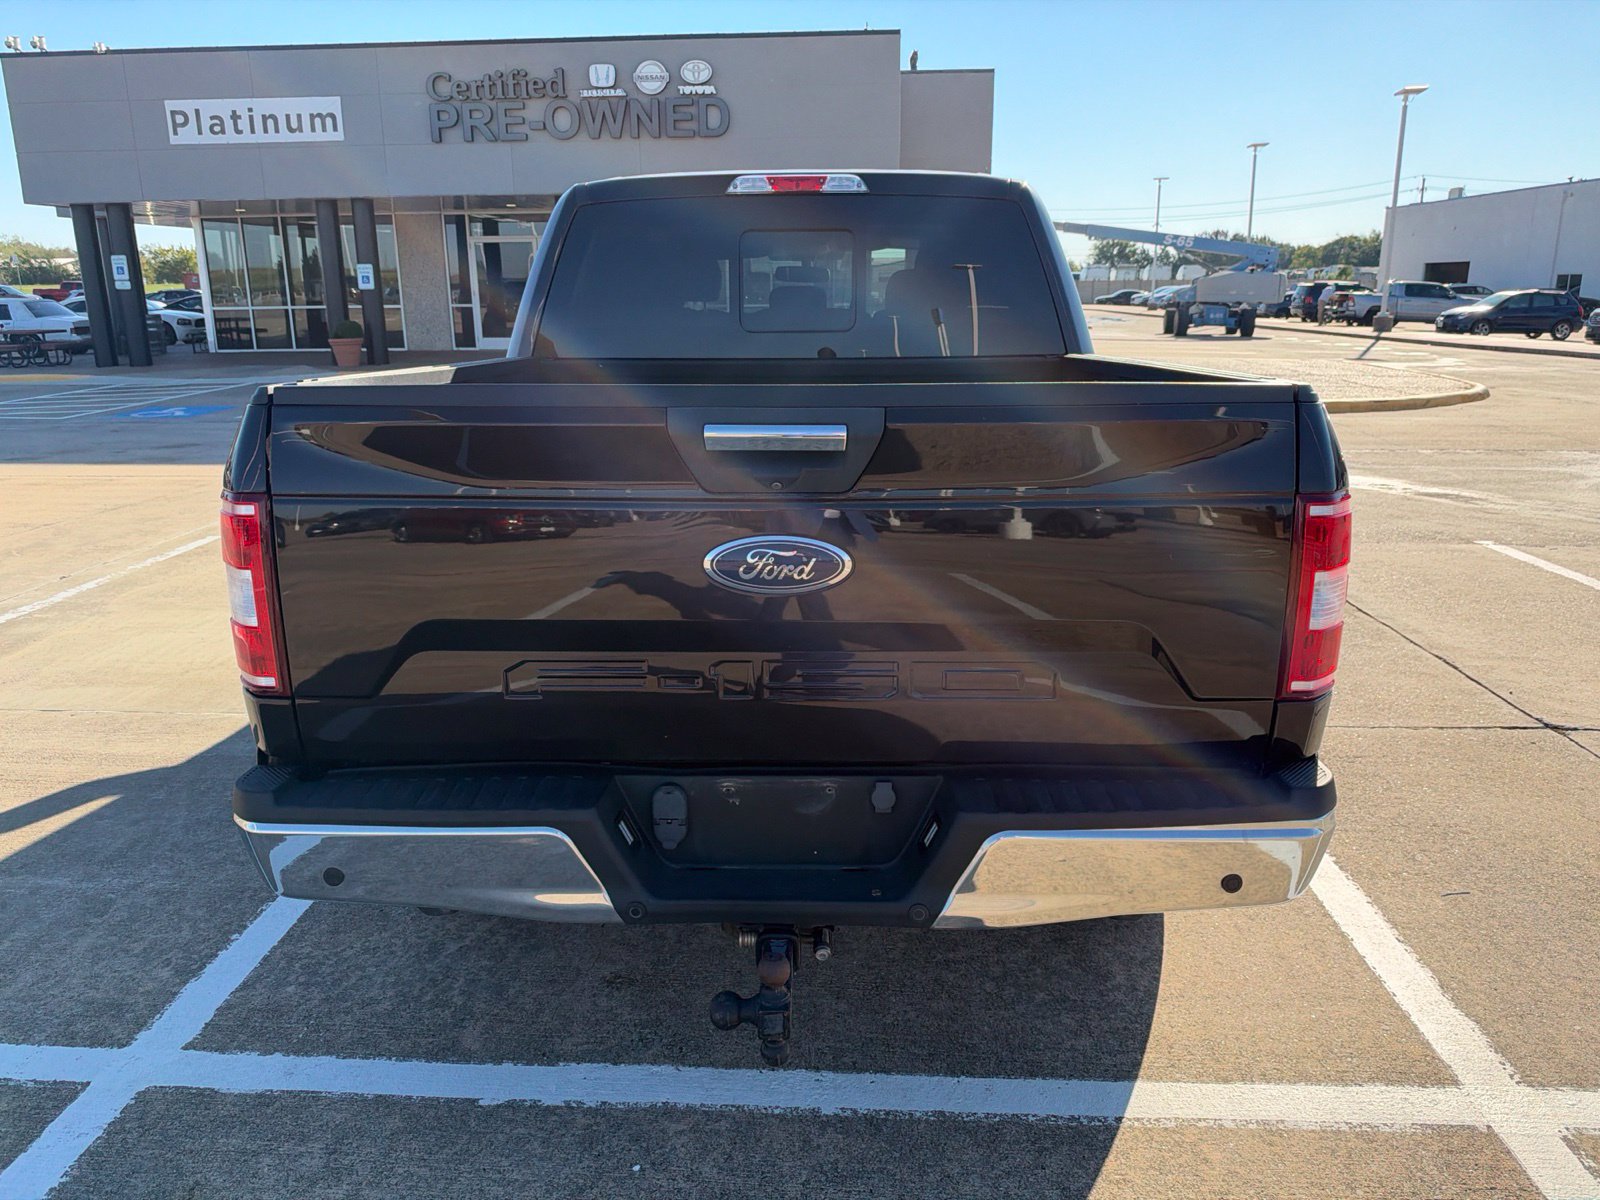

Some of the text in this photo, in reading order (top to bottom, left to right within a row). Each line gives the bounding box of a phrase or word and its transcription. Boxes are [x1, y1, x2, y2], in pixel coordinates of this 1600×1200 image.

[426, 67, 568, 101] Certified
[678, 85, 716, 95] TOYOTA
[170, 108, 338, 136] Platinum
[429, 97, 730, 143] PRE-OWNED
[1163, 235, 1195, 247] S-65
[738, 549, 816, 580] Ford
[503, 659, 1056, 700] F-150
